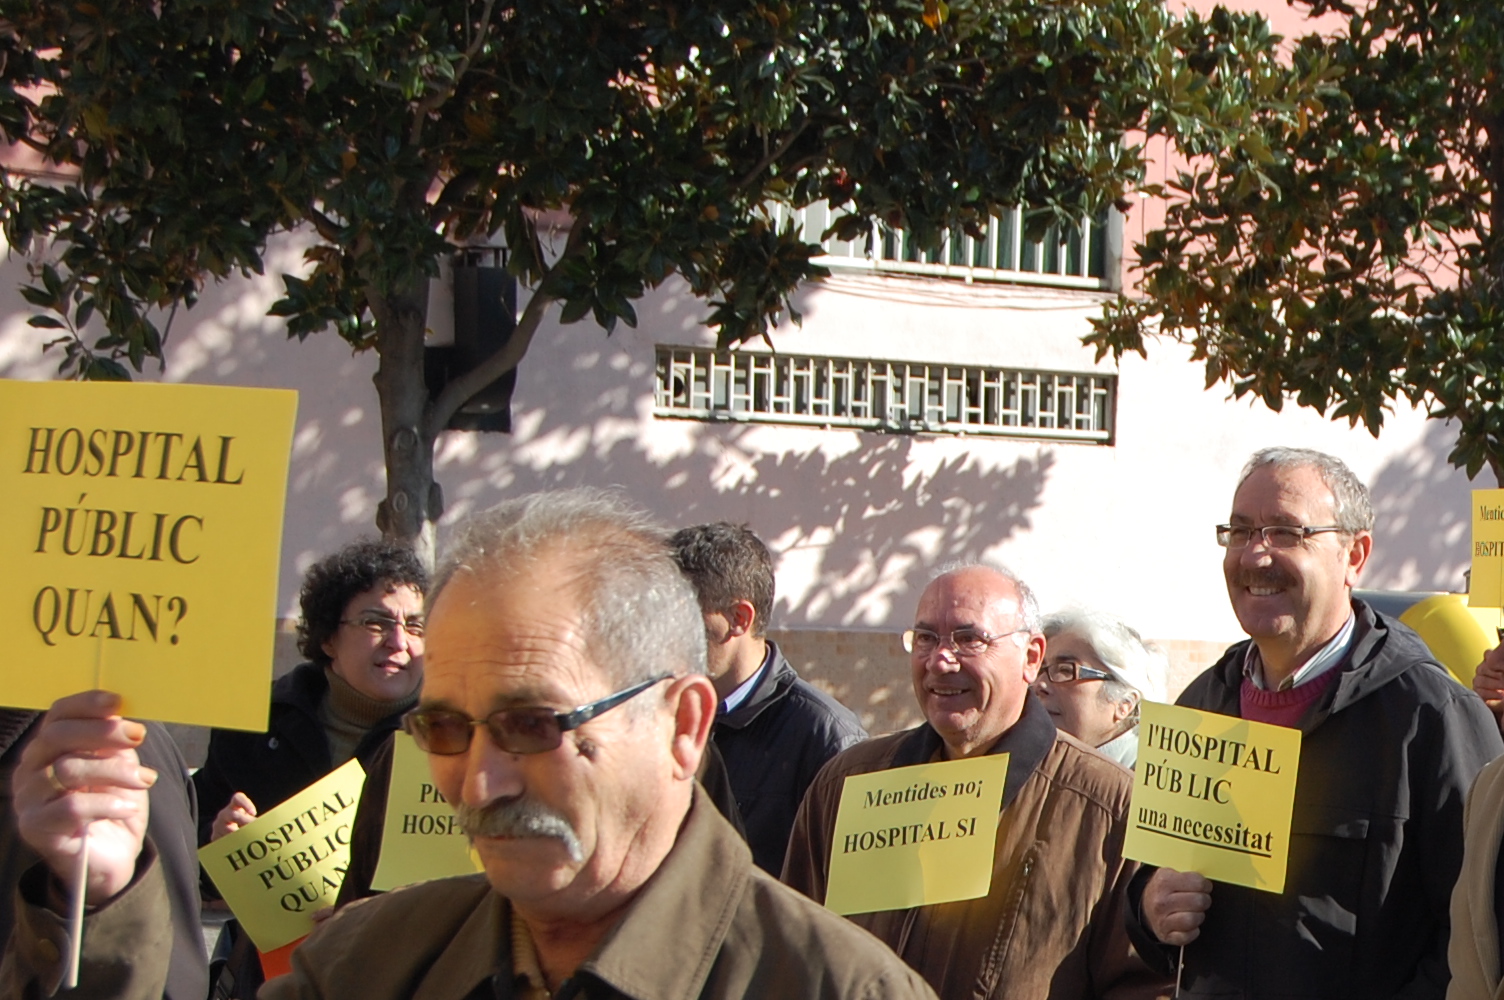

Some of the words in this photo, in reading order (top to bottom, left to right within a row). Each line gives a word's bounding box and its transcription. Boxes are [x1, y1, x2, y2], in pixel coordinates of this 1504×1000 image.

[21, 427, 246, 485] HOSPITAL
[33, 492, 204, 565] PÚBLIC
[33, 585, 188, 646] QUAN?
[1147, 723, 1281, 775] l'HOSPITAL
[863, 782, 947, 809] Mentides
[225, 790, 355, 872] HOSPITAL
[257, 823, 351, 891] PÚBLIC
[843, 821, 951, 854] HOSPITAL
[956, 817, 977, 838] SI
[1138, 807, 1167, 829] una
[1172, 815, 1274, 852] necessitat
